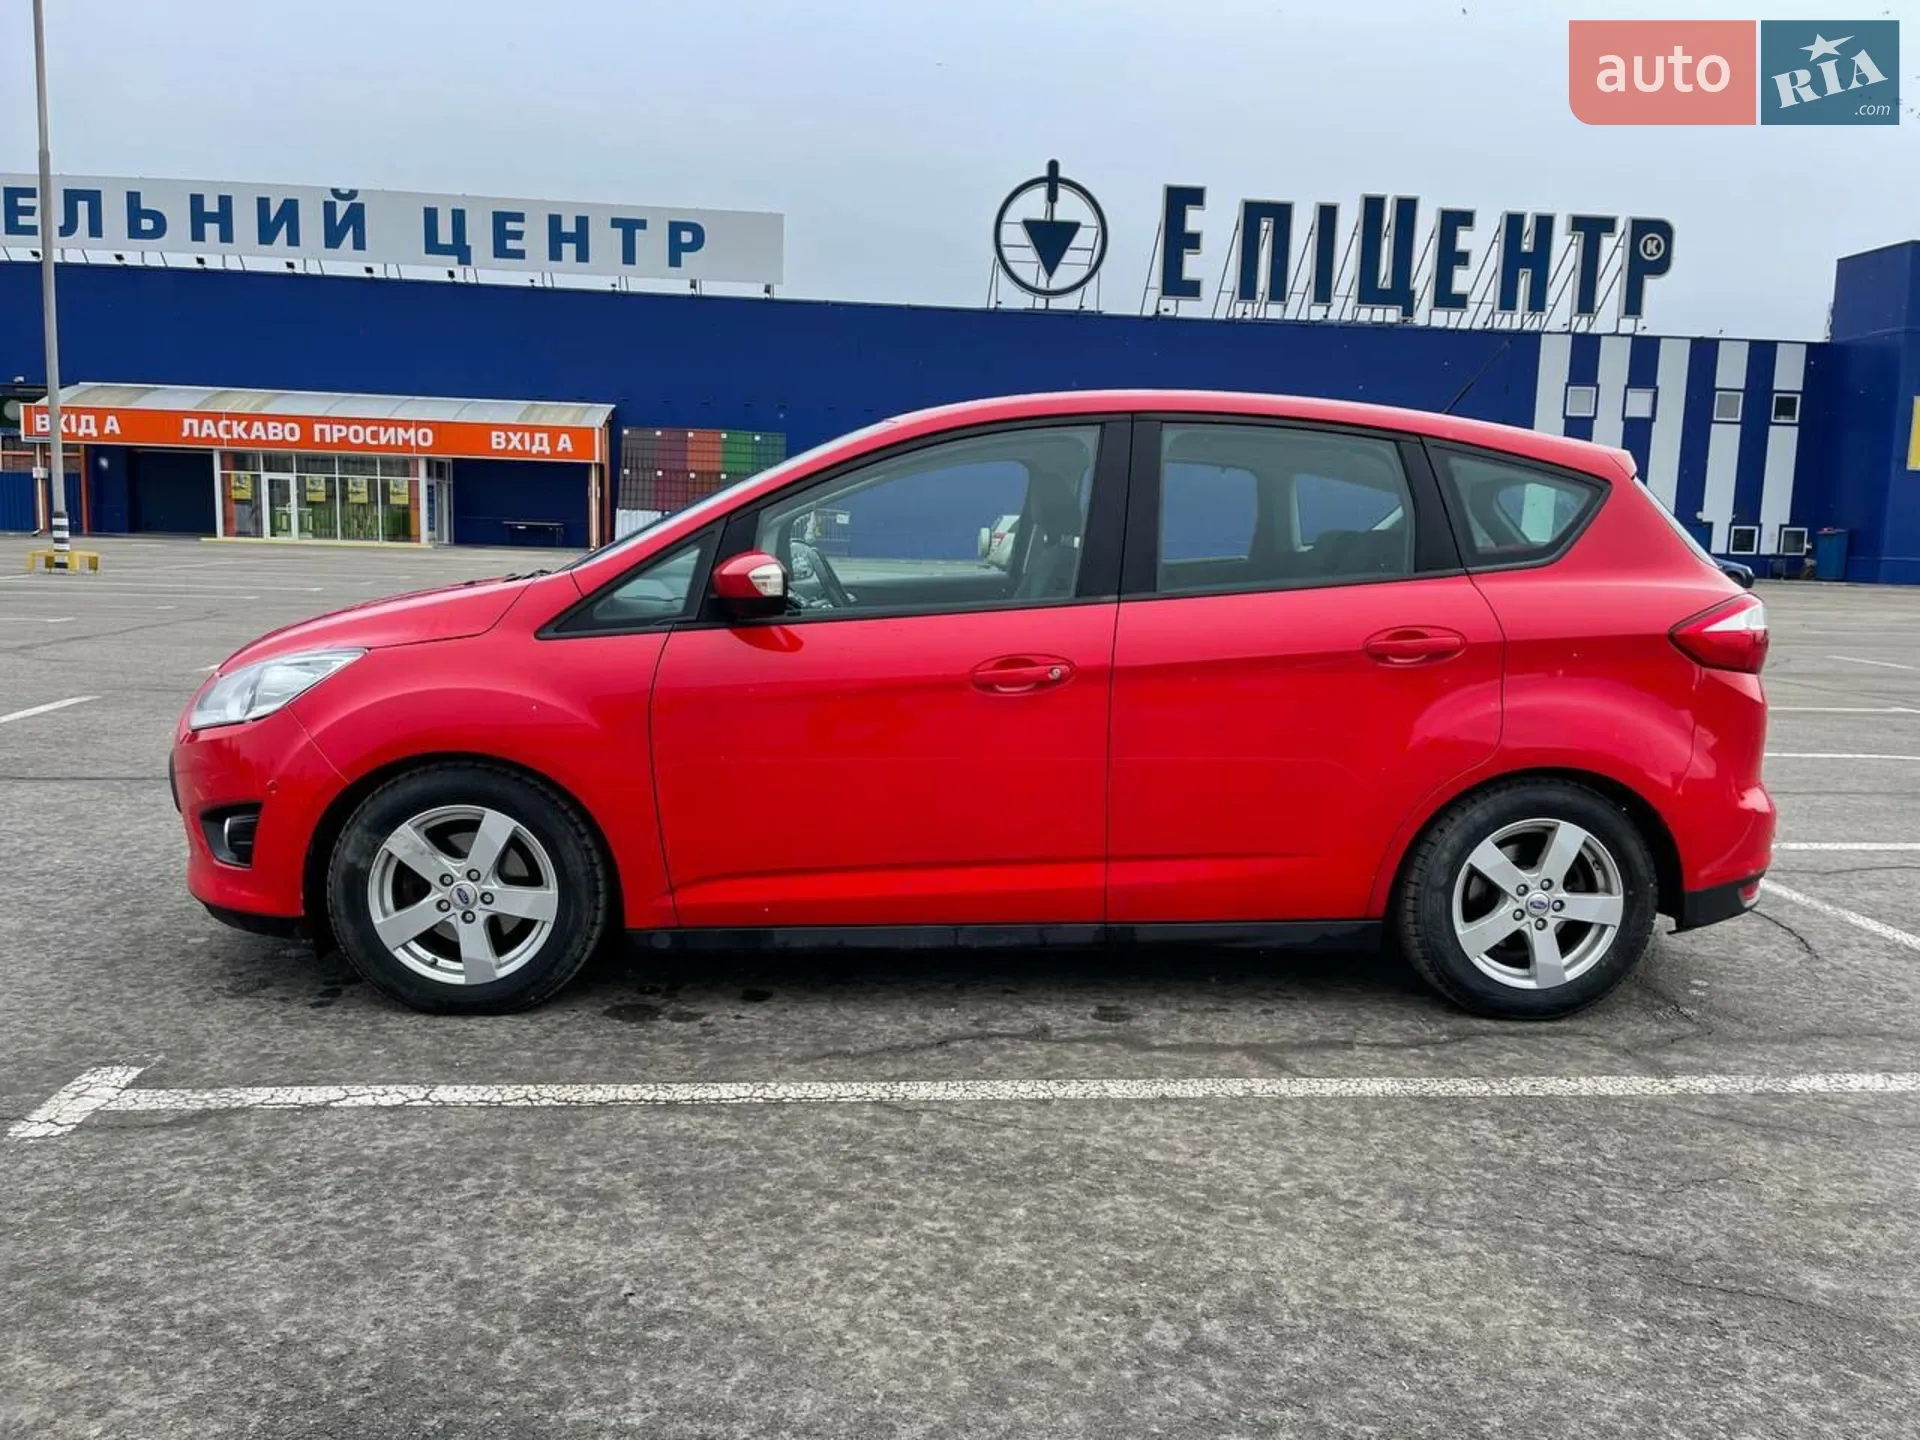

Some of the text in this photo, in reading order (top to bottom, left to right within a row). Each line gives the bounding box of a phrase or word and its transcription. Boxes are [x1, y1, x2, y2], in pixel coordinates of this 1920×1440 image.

[3, 186, 706, 268] ЕЛЬНИЙ ЦЕНТР
[1159, 184, 1676, 321] ЕПІЦЕНТР
[103, 415, 120, 434] А
[181, 418, 434, 447] ЛАСКАВО ПРОСИМО
[491, 431, 574, 455] ВХІД А
